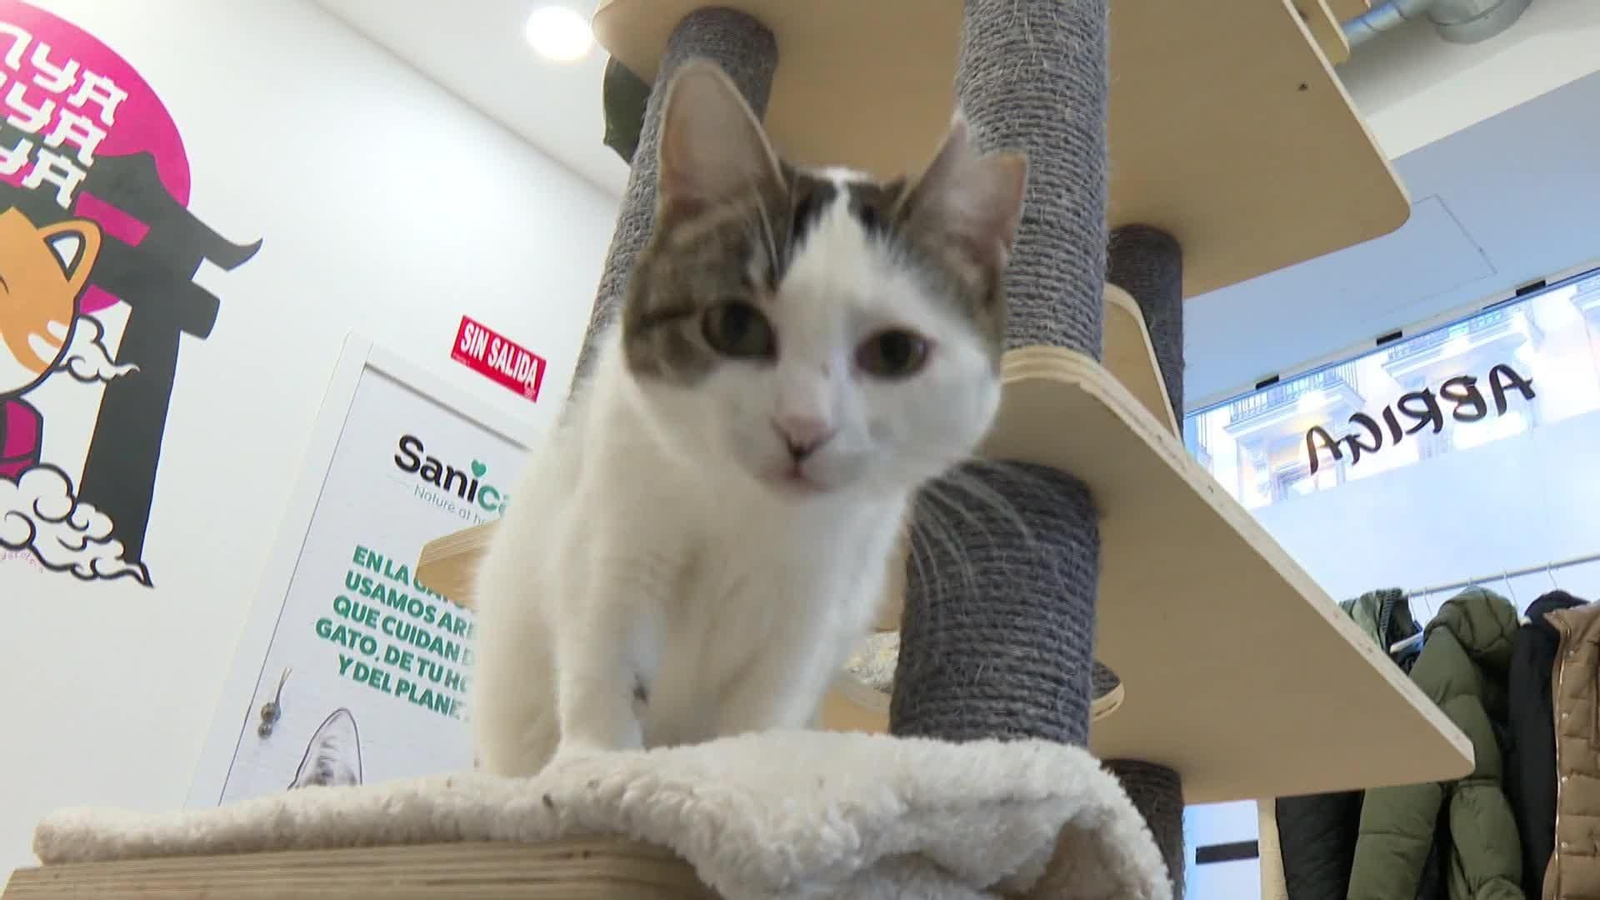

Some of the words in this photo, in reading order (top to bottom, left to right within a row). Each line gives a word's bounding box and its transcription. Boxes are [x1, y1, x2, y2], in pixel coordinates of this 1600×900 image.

[460, 321, 490, 362] SIN
[487, 336, 539, 389] SALIDA
[414, 484, 455, 513] Nature
[459, 507, 471, 520] at
[352, 545, 383, 574] EN
[384, 559, 409, 586] LA
[345, 570, 437, 624] USAMOS
[333, 595, 380, 629] QUE
[381, 616, 460, 663] CUIDAN
[338, 653, 354, 675] Y
[352, 661, 392, 693] DEL
[384, 644, 414, 672] DE
[417, 656, 444, 682] TU
